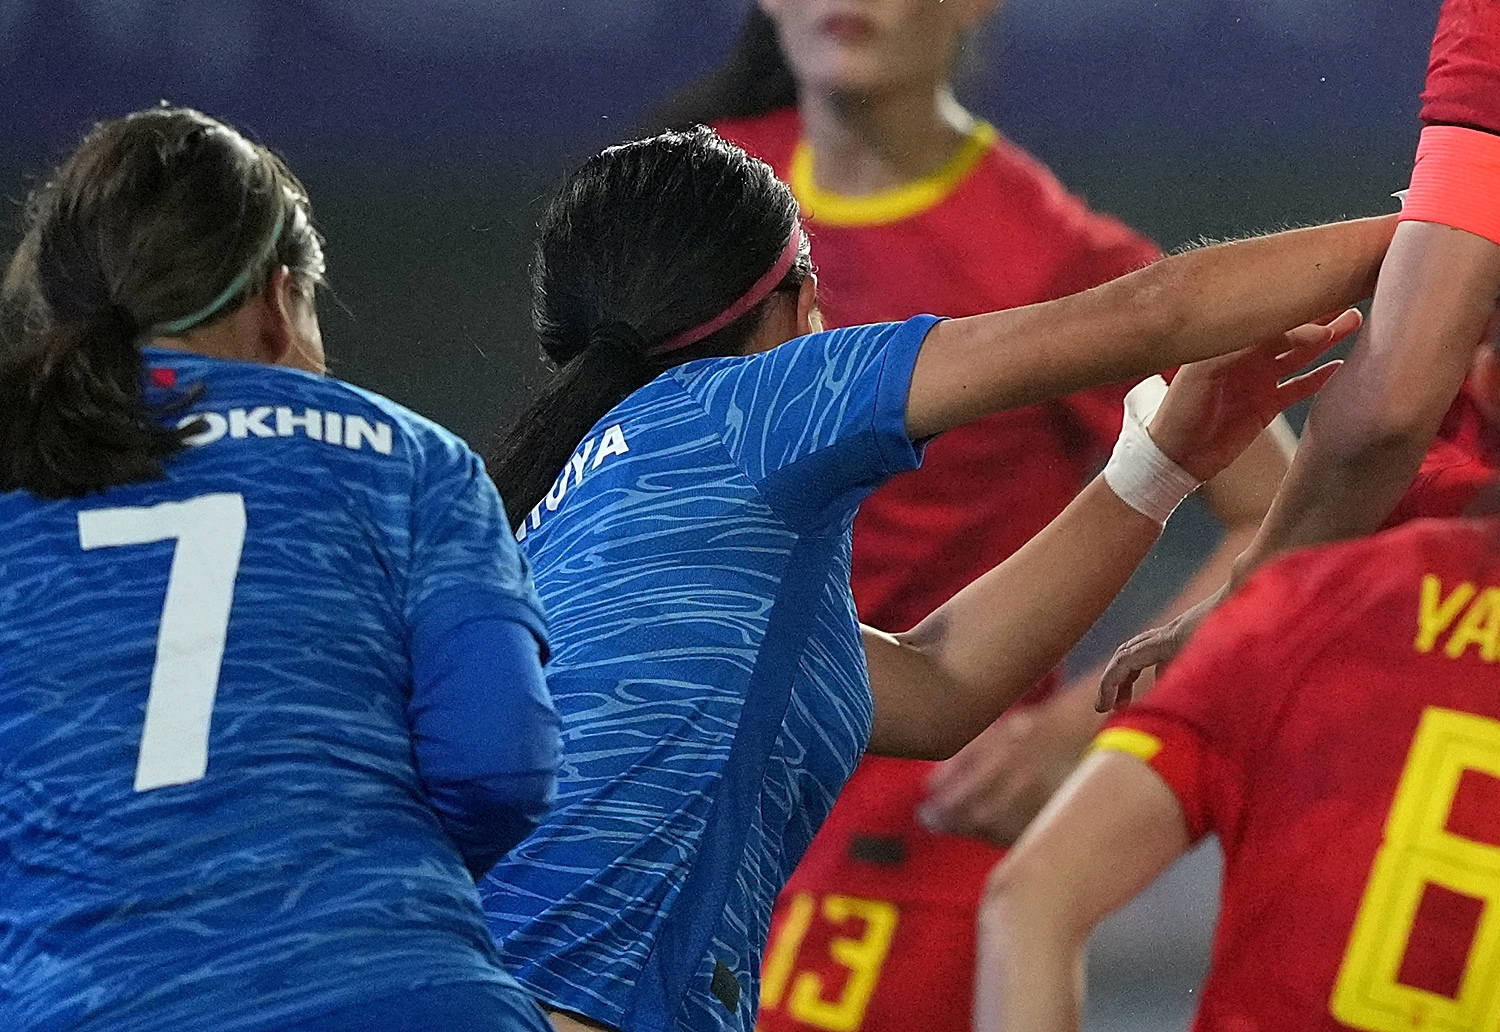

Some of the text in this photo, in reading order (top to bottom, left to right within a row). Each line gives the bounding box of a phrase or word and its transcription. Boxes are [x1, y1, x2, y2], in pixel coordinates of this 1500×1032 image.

[175, 405, 393, 455] OKHIN
[78, 493, 247, 792] 7
[759, 890, 900, 1032] 13
